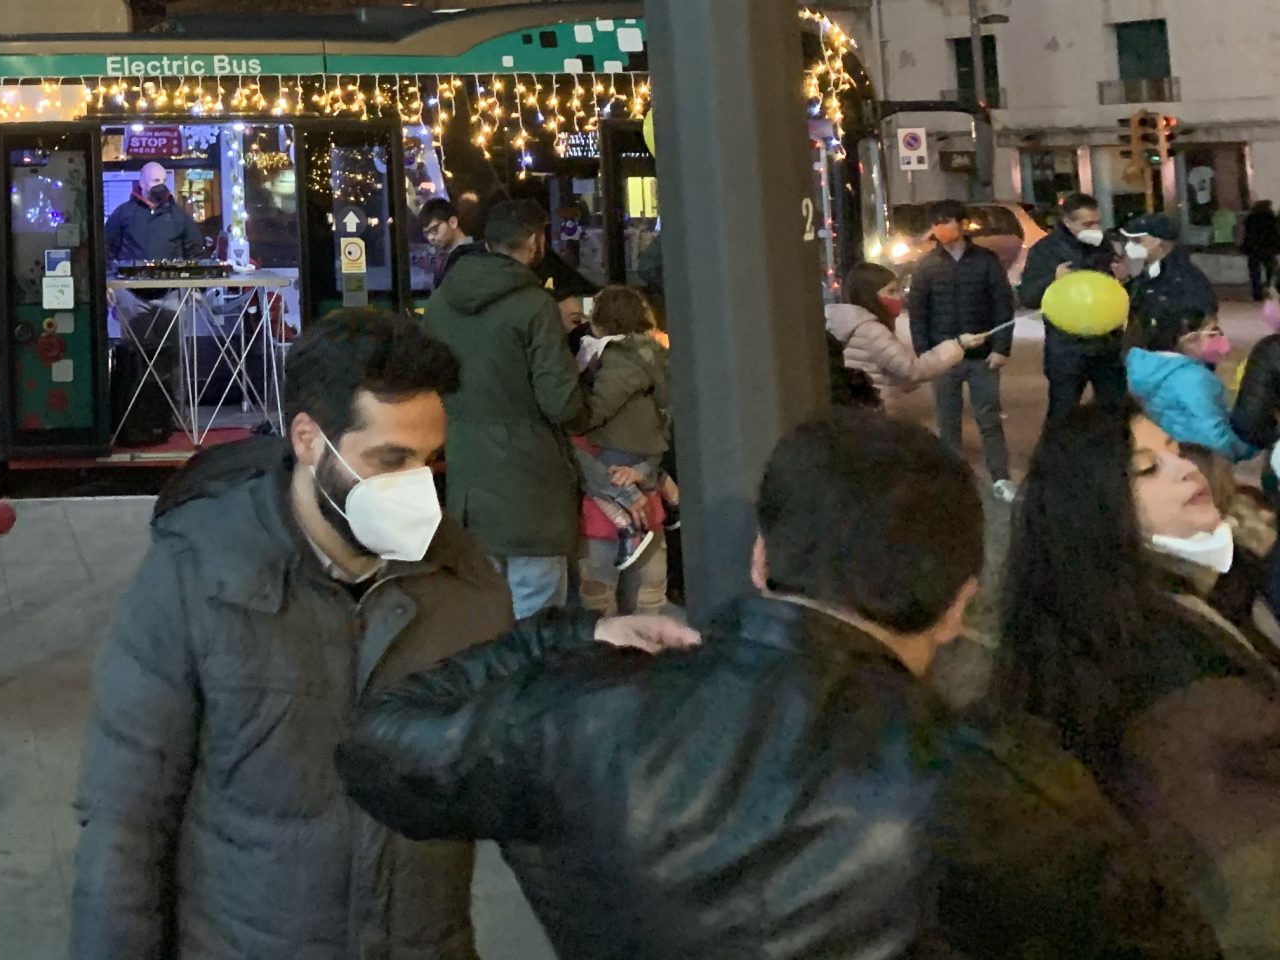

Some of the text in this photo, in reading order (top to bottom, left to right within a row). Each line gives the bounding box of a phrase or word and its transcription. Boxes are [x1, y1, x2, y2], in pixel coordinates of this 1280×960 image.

[106, 54, 262, 76] Electric Bus
[130, 136, 167, 147] STOP
